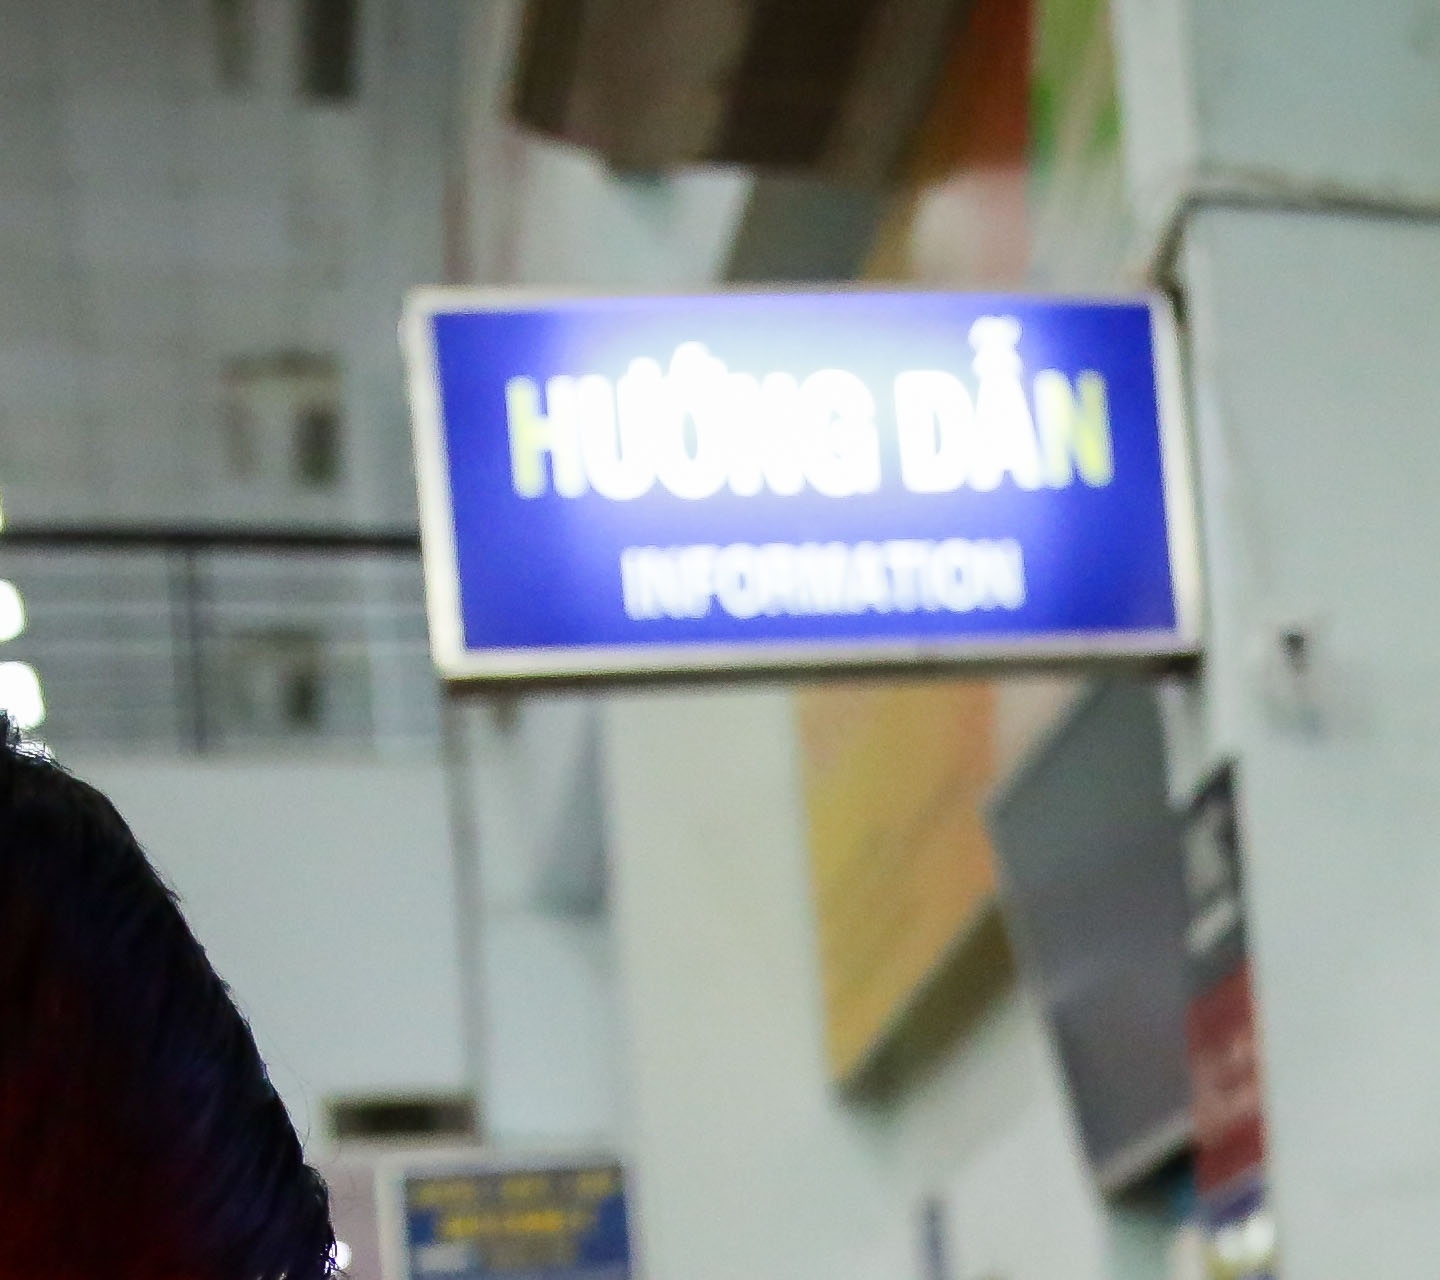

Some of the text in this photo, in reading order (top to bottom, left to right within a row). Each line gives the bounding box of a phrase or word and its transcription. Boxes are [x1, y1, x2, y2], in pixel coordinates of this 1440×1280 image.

[504, 313, 1116, 503] HƯỚNG DẪN
[618, 536, 1028, 622] INFORMATION
